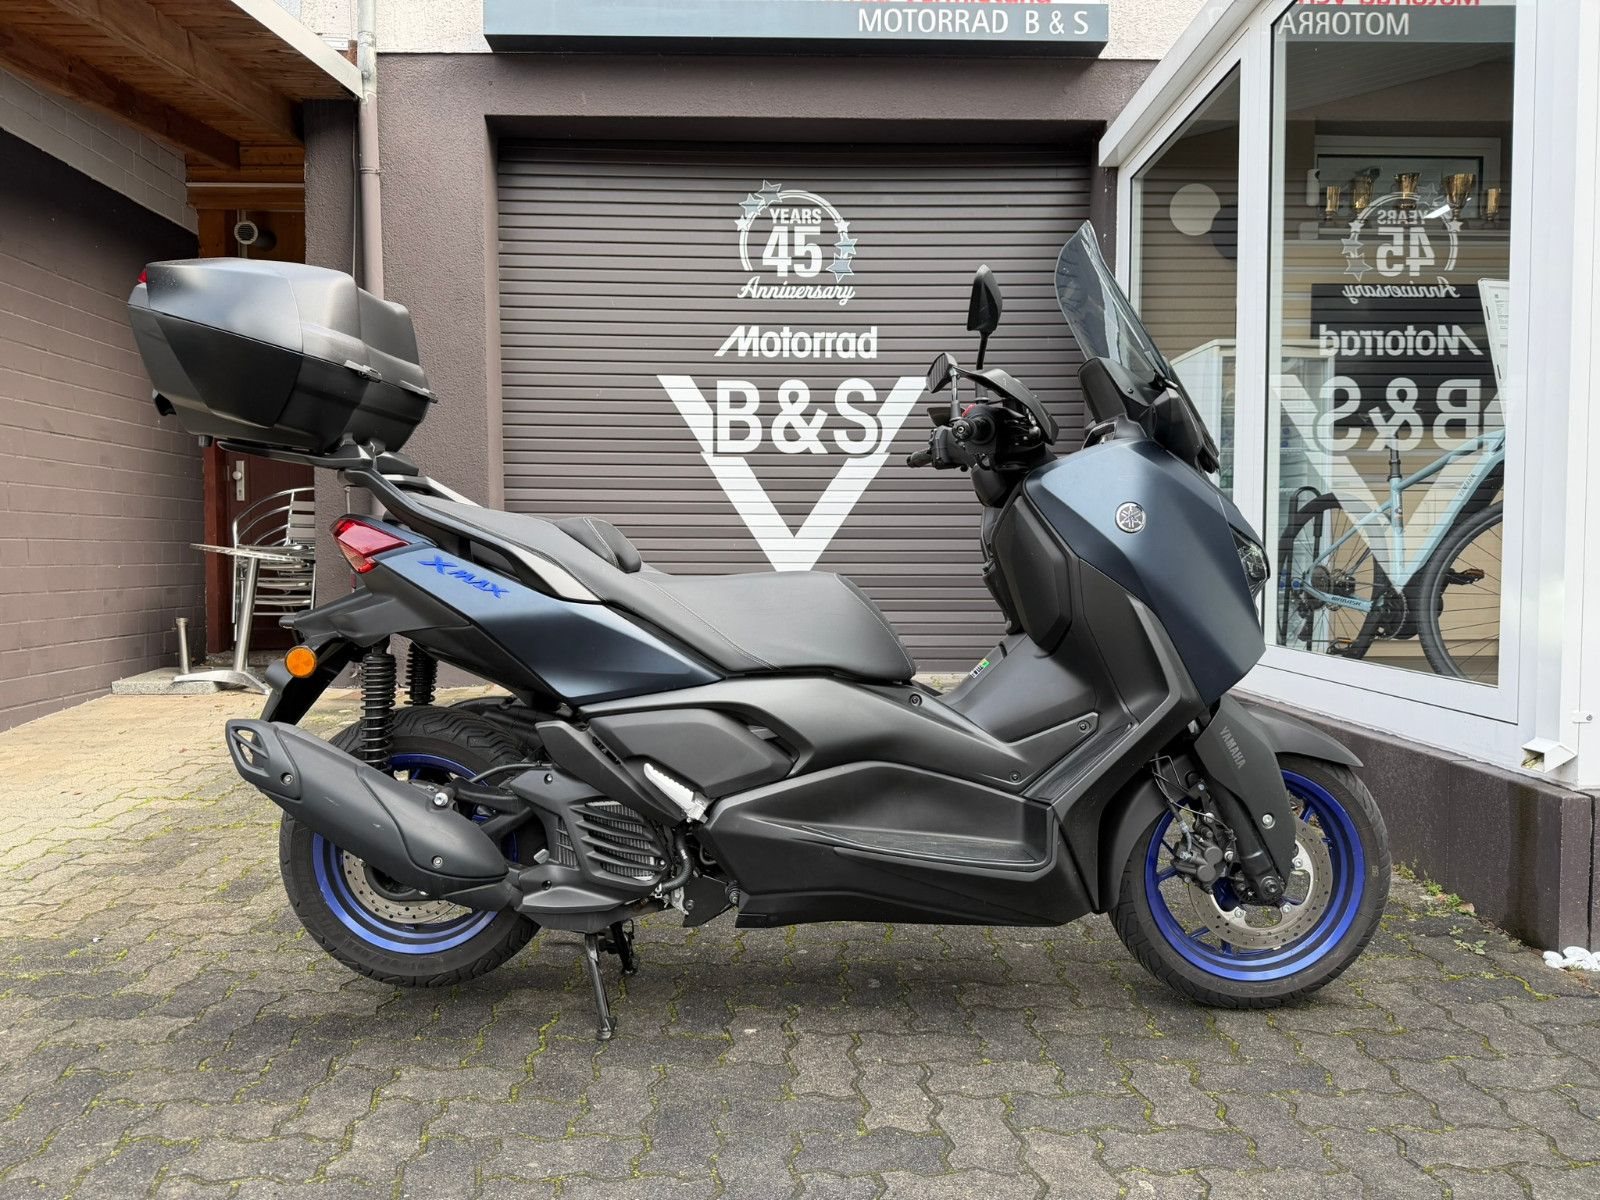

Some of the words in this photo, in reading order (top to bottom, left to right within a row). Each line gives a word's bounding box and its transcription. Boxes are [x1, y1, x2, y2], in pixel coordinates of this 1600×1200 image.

[859, 8, 1008, 33] MOTORRAD
[1025, 10, 1040, 34] B
[1049, 10, 1065, 35] &
[1074, 10, 1089, 35] S
[769, 207, 822, 225] YEARS
[762, 225, 823, 278] 45
[737, 275, 855, 306] Anniversary
[713, 325, 878, 359] Motorrad
[716, 377, 879, 455] B&S
[417, 553, 510, 599] XMAX
[1220, 725, 1246, 769] YAMAHA
